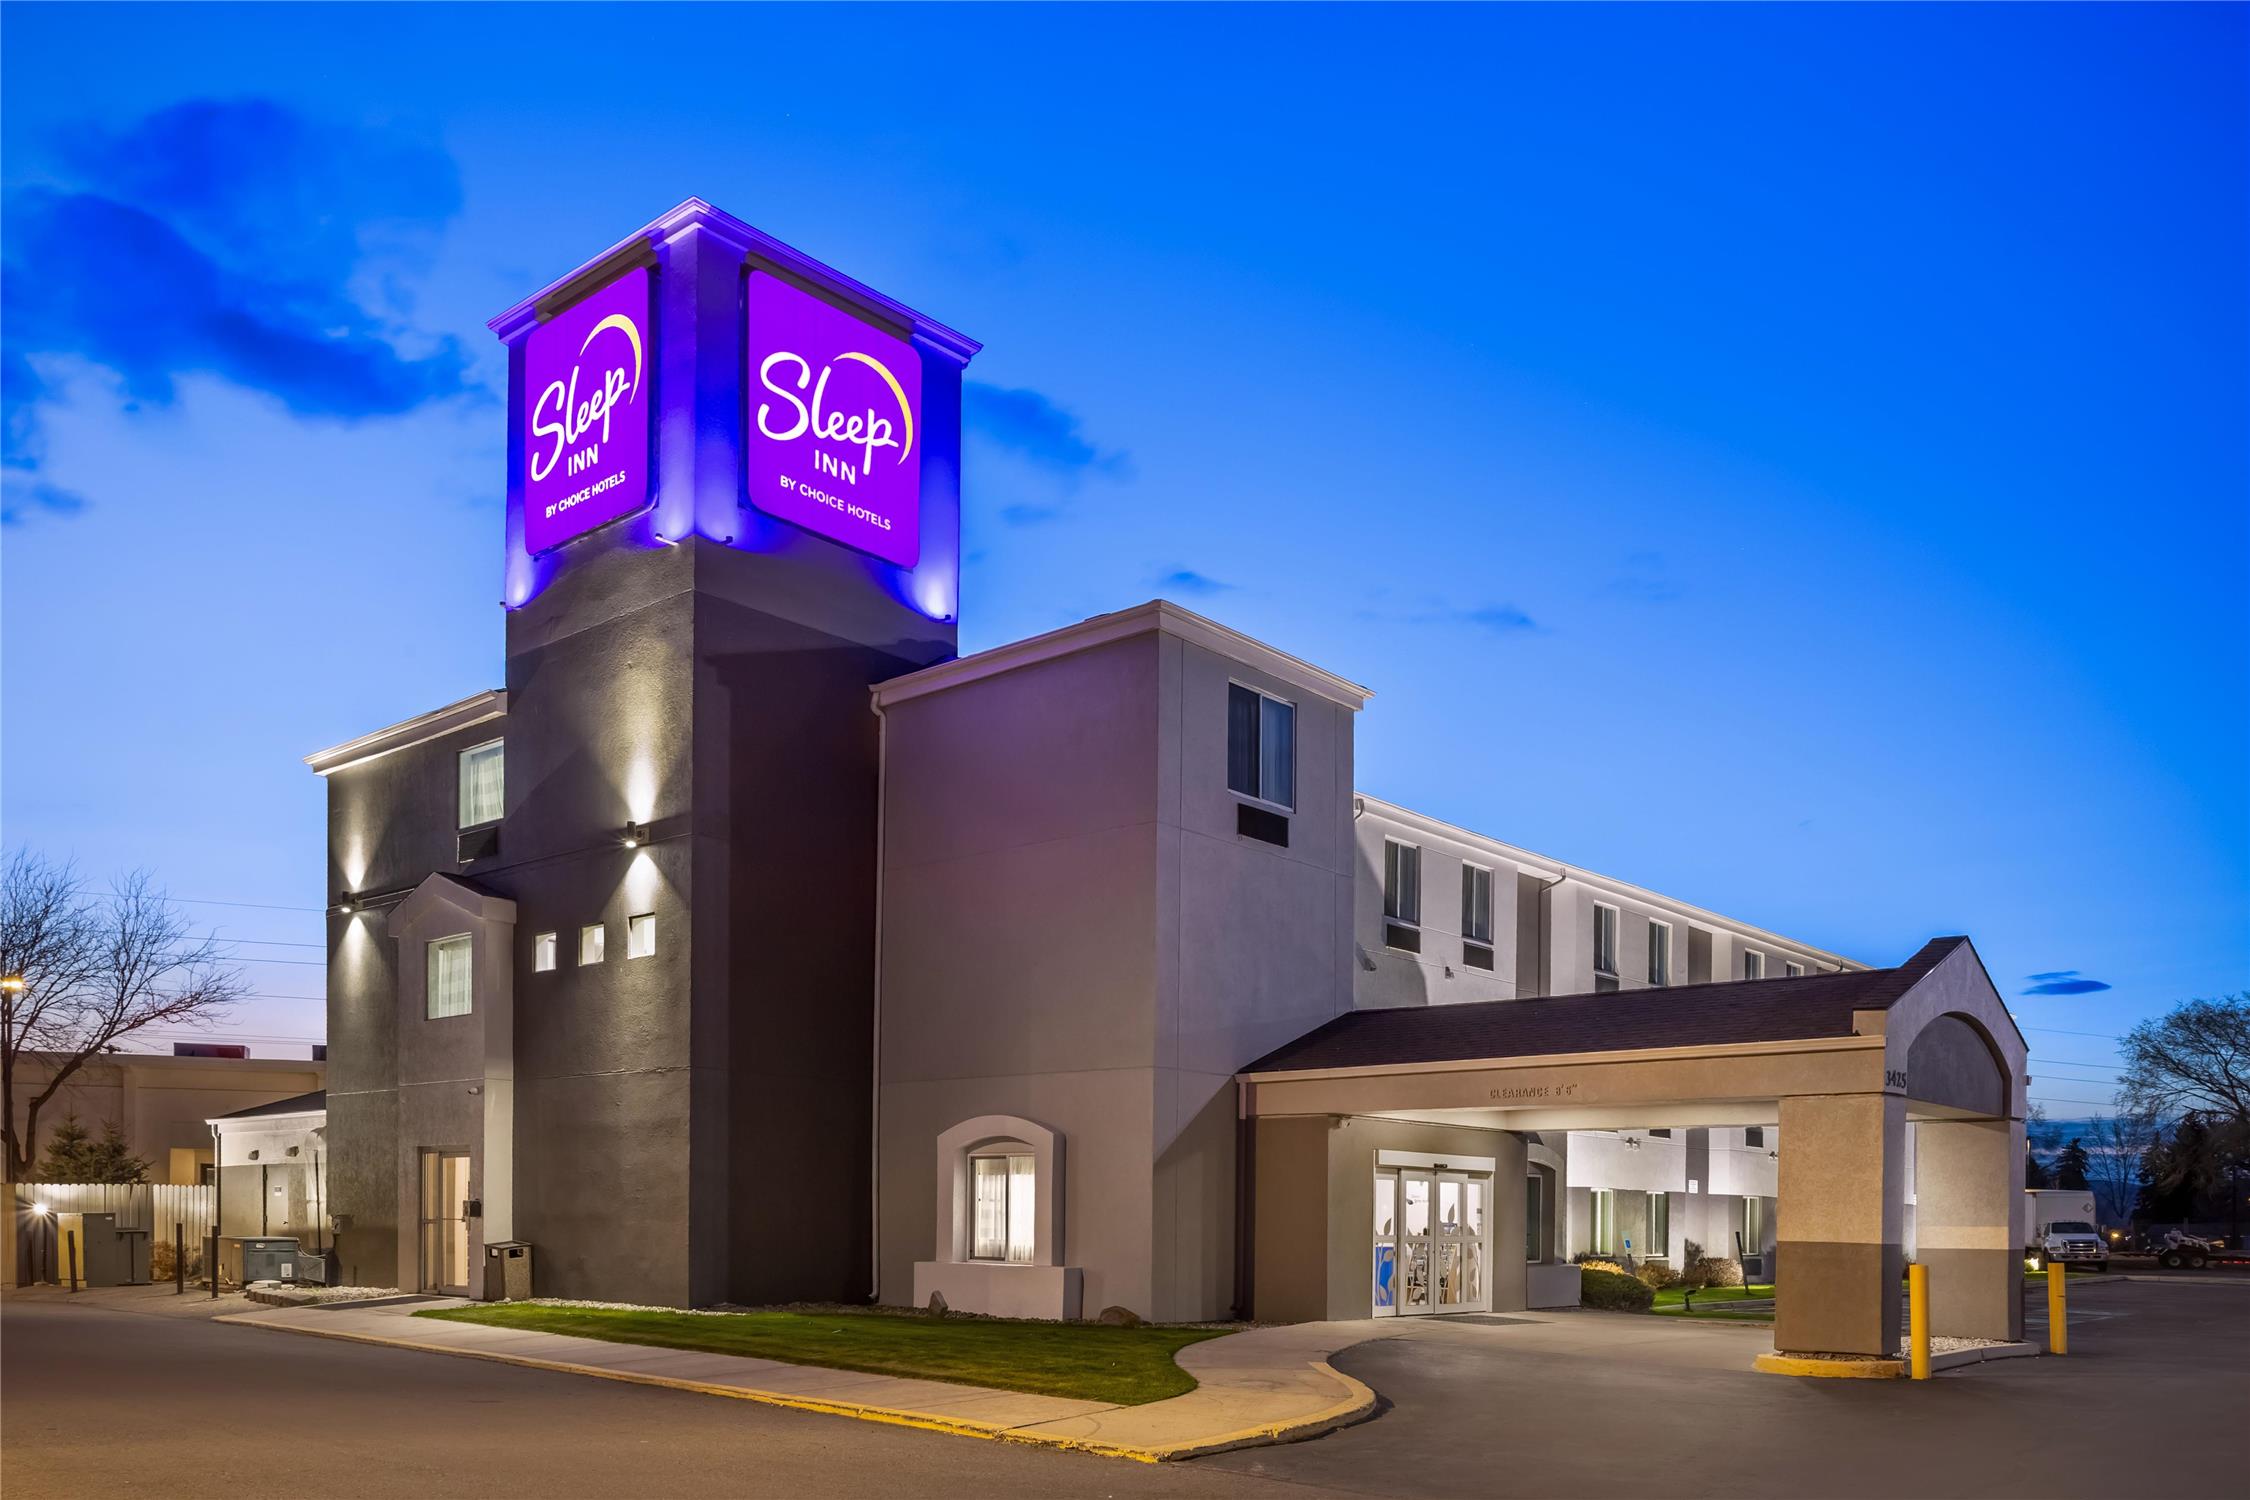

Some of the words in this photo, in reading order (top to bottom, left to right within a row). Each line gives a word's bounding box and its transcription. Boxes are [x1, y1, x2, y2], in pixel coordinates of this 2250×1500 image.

[530, 365, 631, 482] Sleep
[757, 351, 899, 476] Sleep
[567, 443, 599, 477] INN
[814, 449, 856, 485] INN
[545, 504, 559, 519] BY
[558, 487, 591, 513] CHOICE
[591, 471, 626, 498] HOTELS
[780, 474, 797, 491] BY
[799, 483, 845, 512] CHOICE
[847, 503, 892, 531] HOTELS
[1489, 1087, 1549, 1099] CLEARANCE
[1886, 1070, 1907, 1089] 3425
